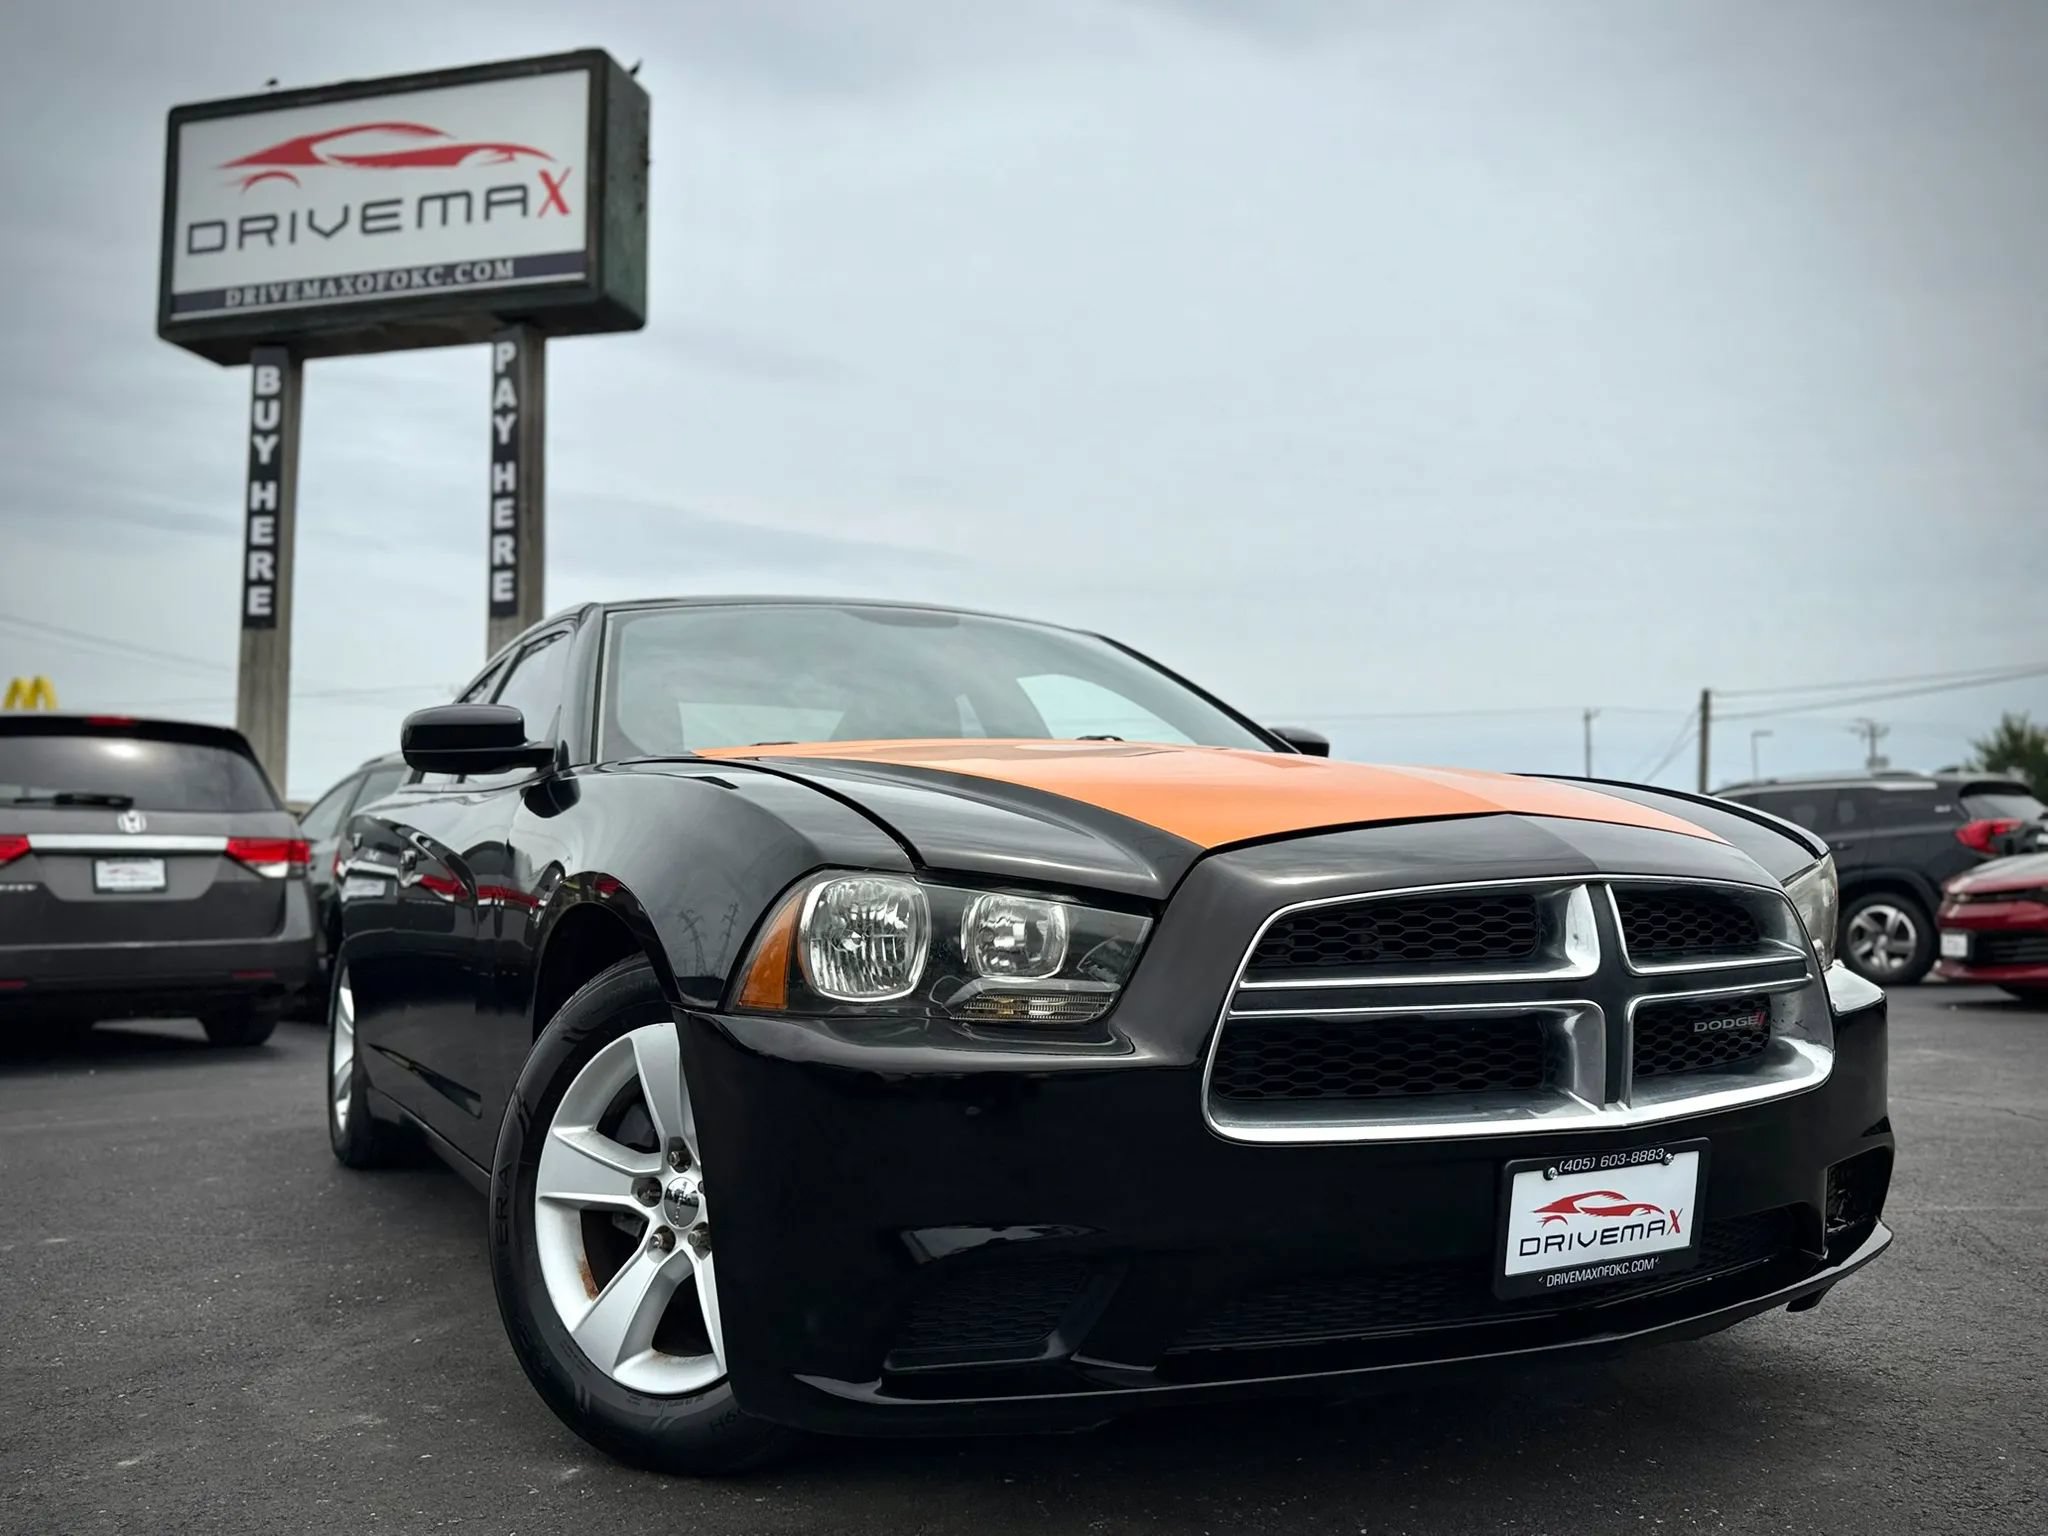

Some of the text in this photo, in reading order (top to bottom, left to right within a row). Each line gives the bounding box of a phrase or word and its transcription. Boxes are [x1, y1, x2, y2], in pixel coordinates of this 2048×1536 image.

[187, 167, 572, 256] DRIVEMAX
[225, 259, 515, 307] DRIVEMAXOFOKC.COM
[247, 365, 281, 616] BUY HERE
[492, 342, 517, 602] PAY HERE
[1694, 1015, 1758, 1033] DODGE
[1559, 1148, 1665, 1173] (405) 603-8883
[1519, 1208, 1684, 1257] DRIVEMAX
[1546, 1257, 1655, 1287] DRIVEMAXOFOKC.COM
